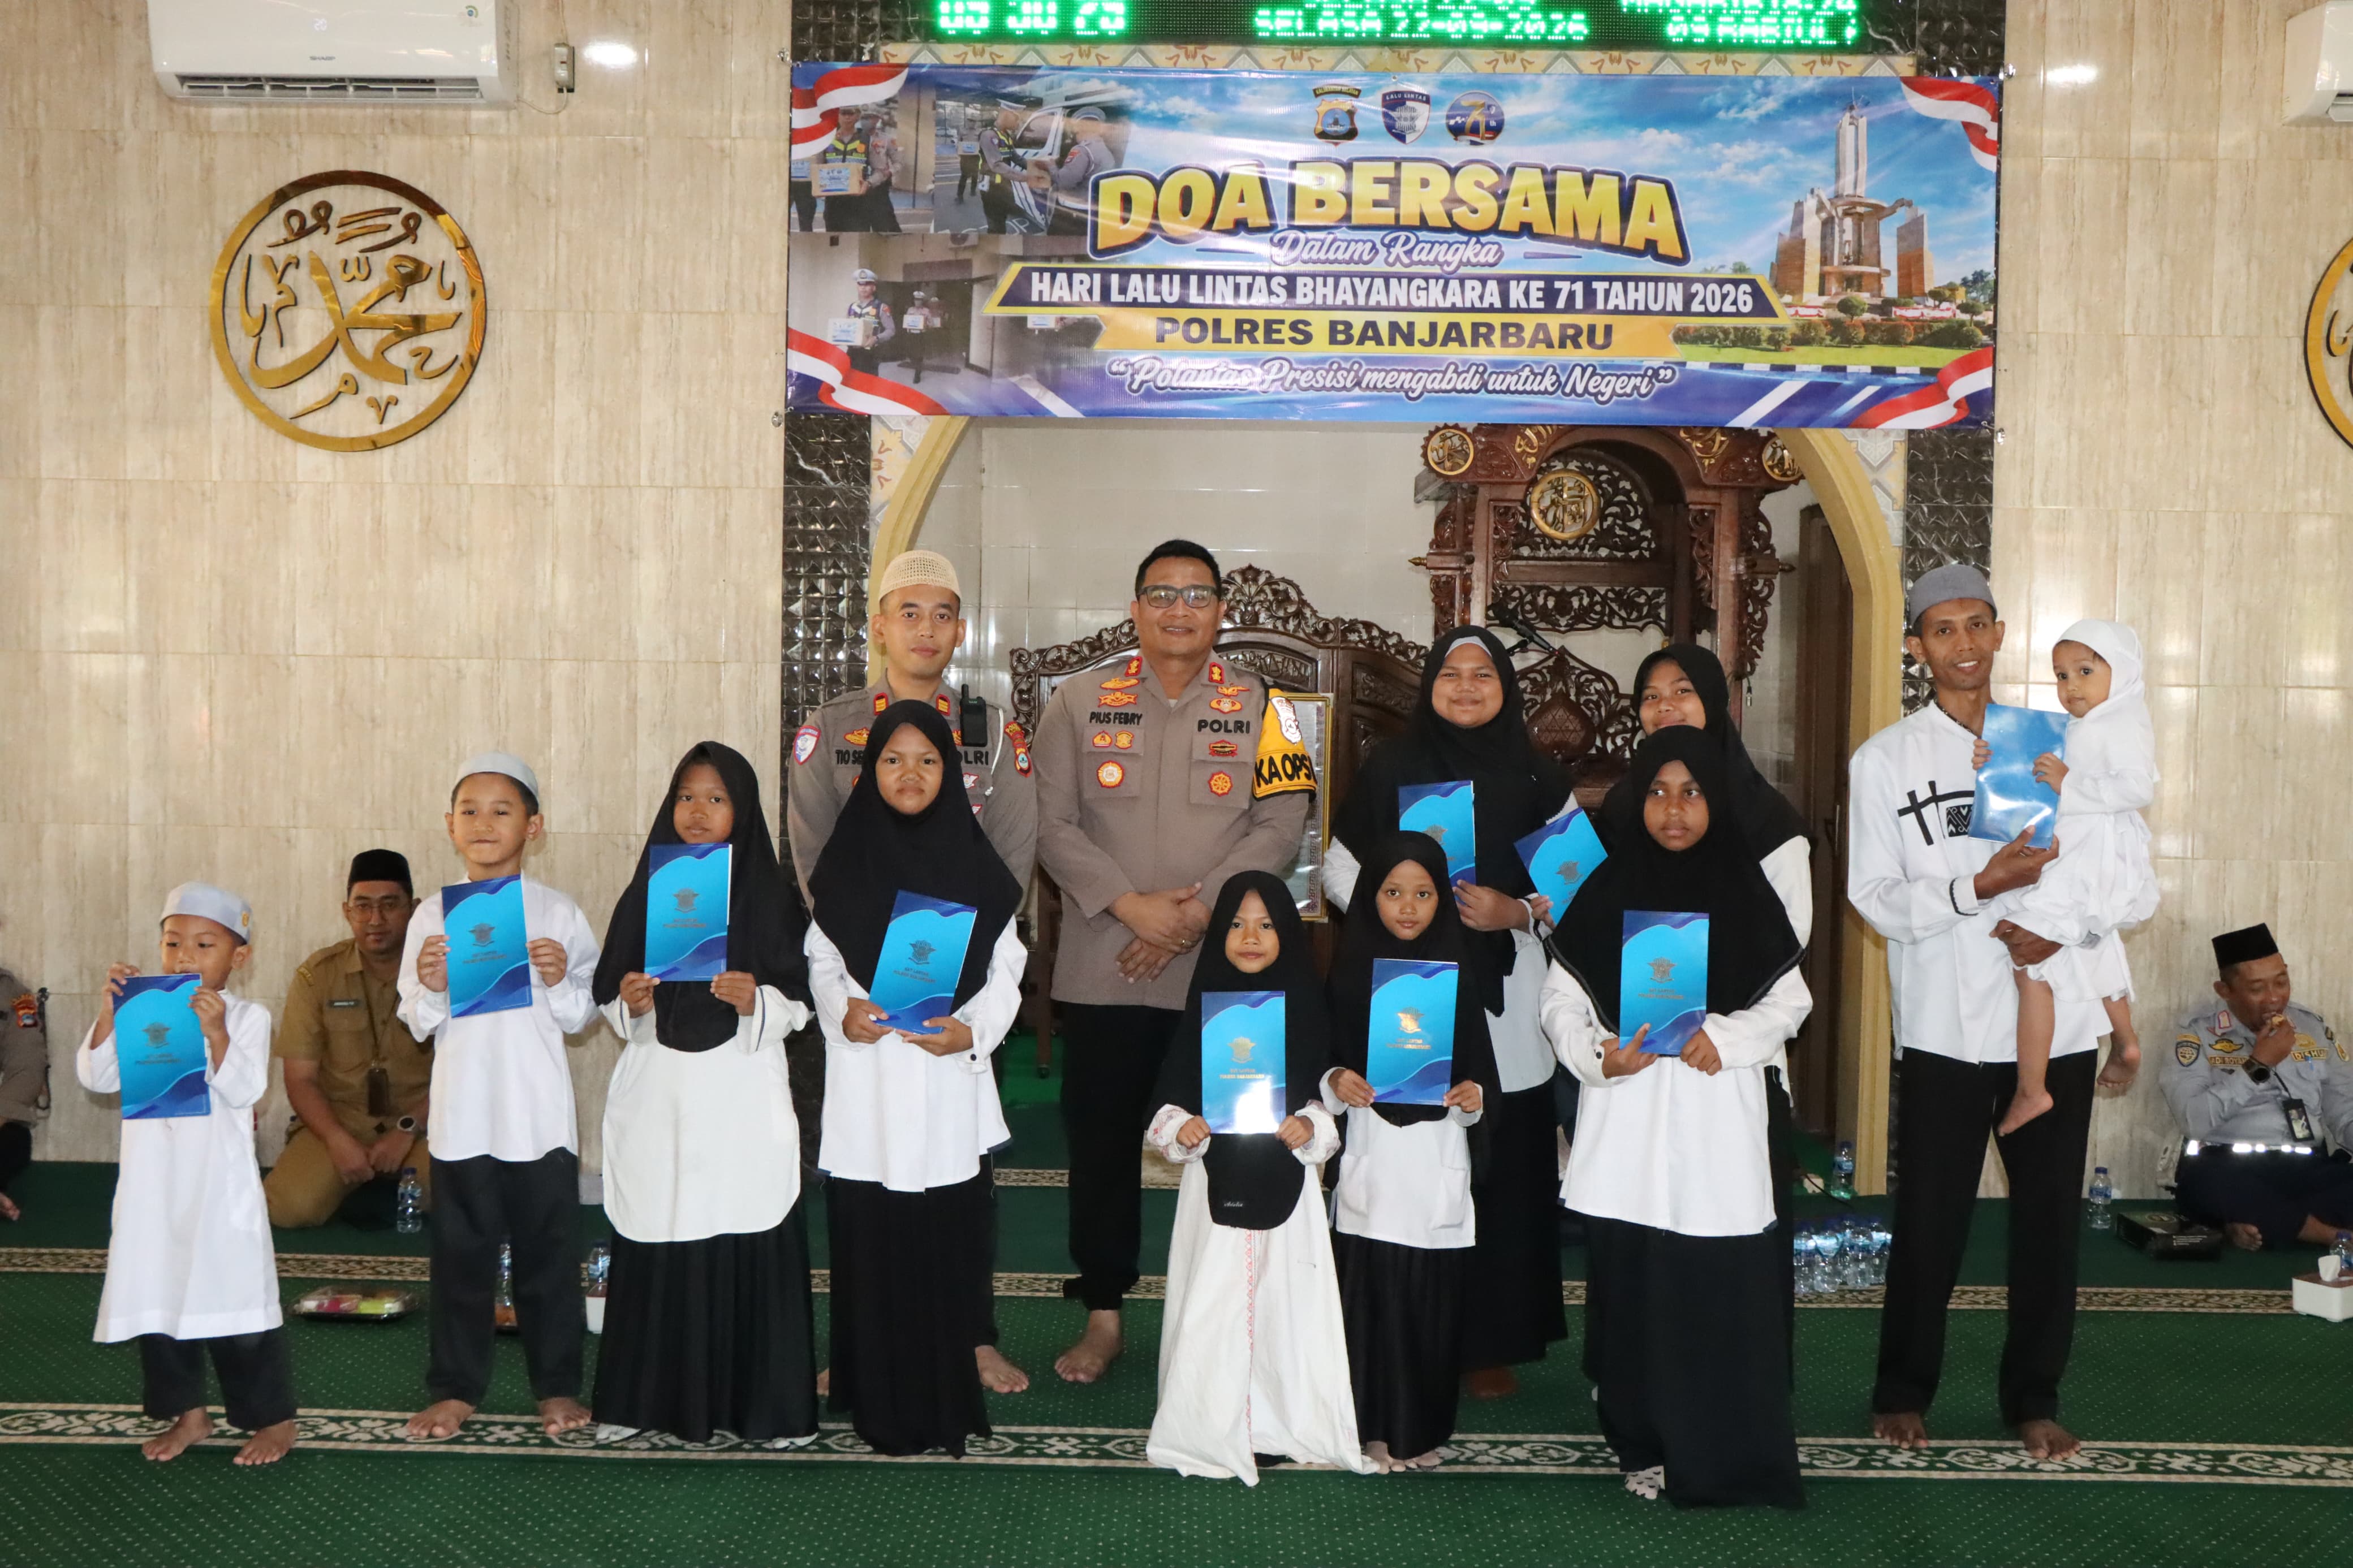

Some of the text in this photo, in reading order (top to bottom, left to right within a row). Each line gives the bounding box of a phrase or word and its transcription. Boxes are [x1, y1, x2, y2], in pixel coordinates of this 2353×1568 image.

[1255, 10, 1381, 36] SELASA
[1094, 159, 1686, 260] DOA BERSAMA
[1273, 230, 1502, 271] Dalam Rangka
[1031, 271, 1753, 313] HARI LALU LINTAS BHAYANGKARA KE 71 TAHUN 2026
[1156, 317, 1614, 350] POLRES BANJARBARU
[1262, 357, 1361, 392] Presisi
[1361, 364, 1483, 397] mengabdi
[1488, 365, 1560, 393] untuk
[1089, 711, 1143, 725] PIUS FEBRY
[1197, 719, 1250, 734] POLRI
[835, 749, 850, 765] TIO
[1254, 755, 1283, 788] KA
